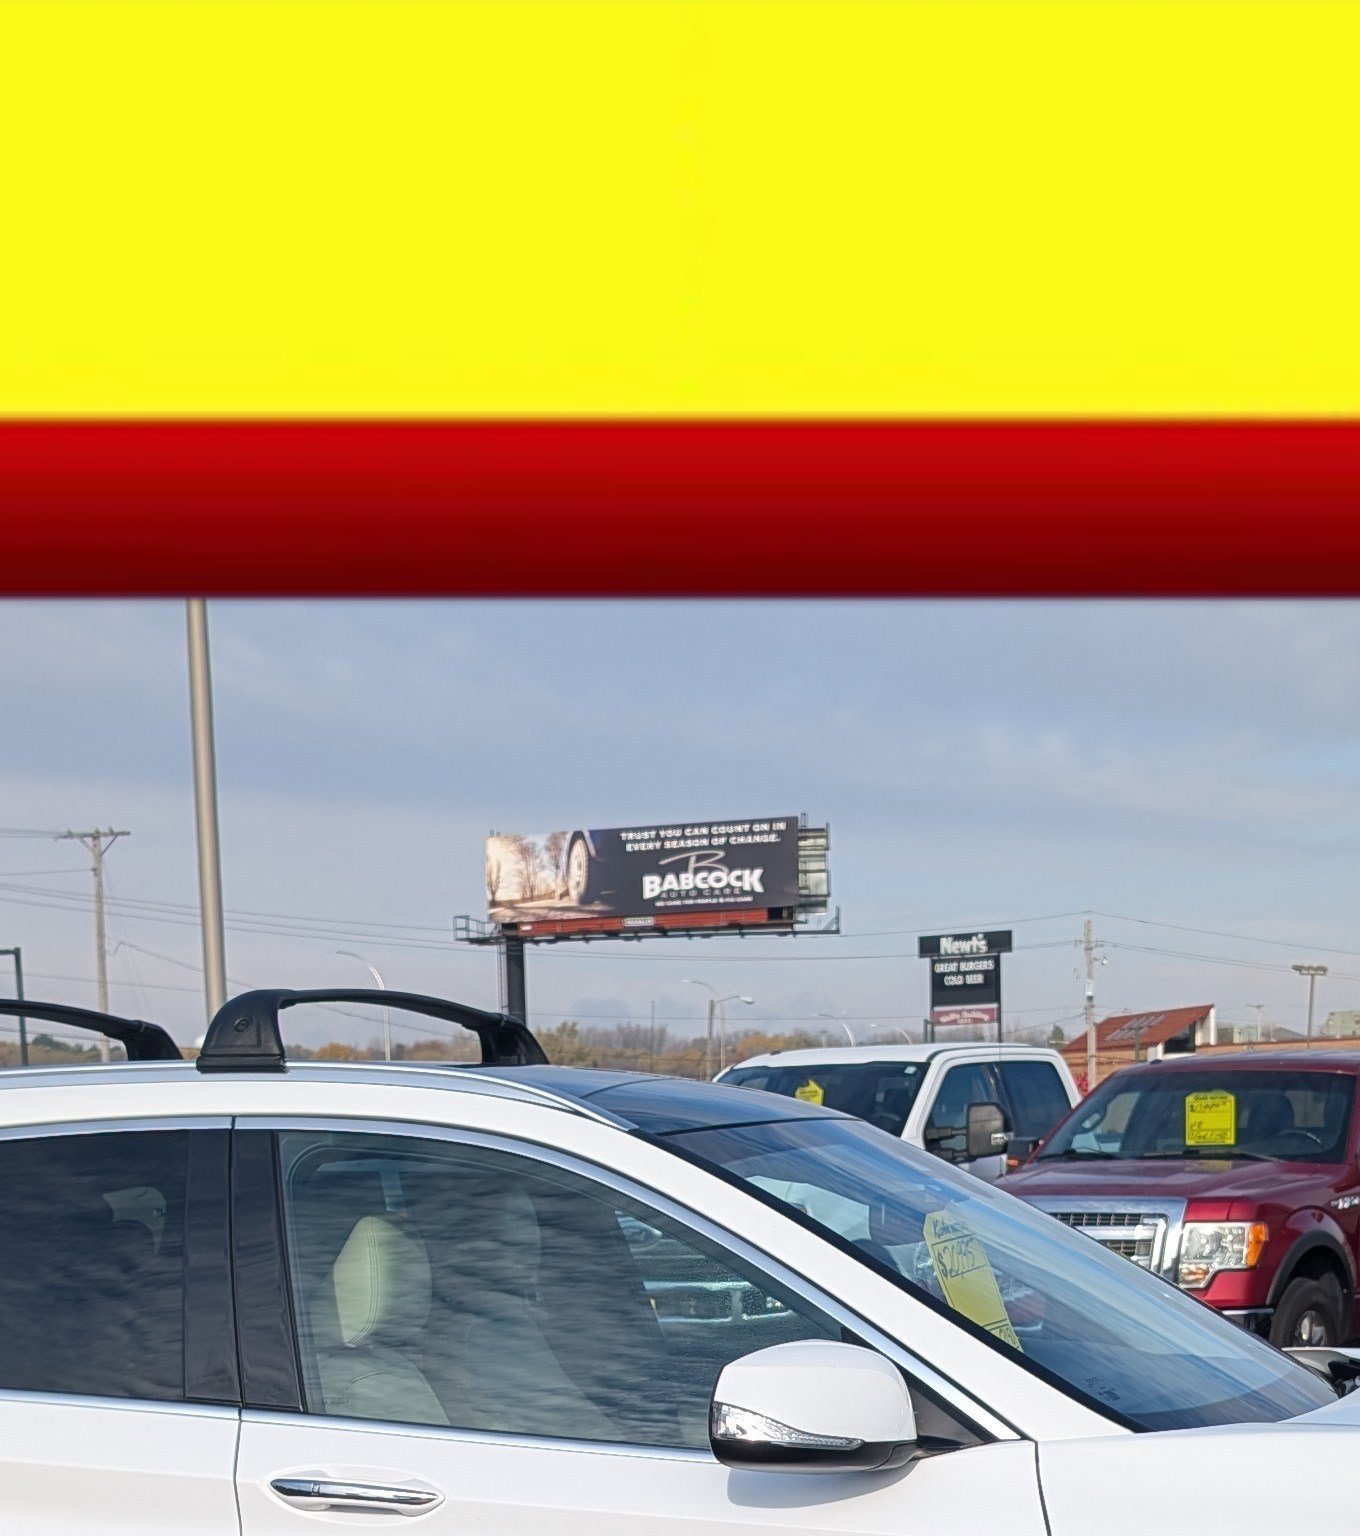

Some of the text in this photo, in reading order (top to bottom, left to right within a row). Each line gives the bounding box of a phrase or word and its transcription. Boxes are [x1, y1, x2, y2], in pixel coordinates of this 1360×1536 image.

[620, 821, 787, 840] TRUST YOU CAN COUNT ON IN
[625, 841, 662, 851] EVERY
[663, 838, 709, 849] SEASON
[711, 837, 727, 846] OF
[643, 868, 765, 899] BABCOCK
[939, 933, 989, 954] Newt's
